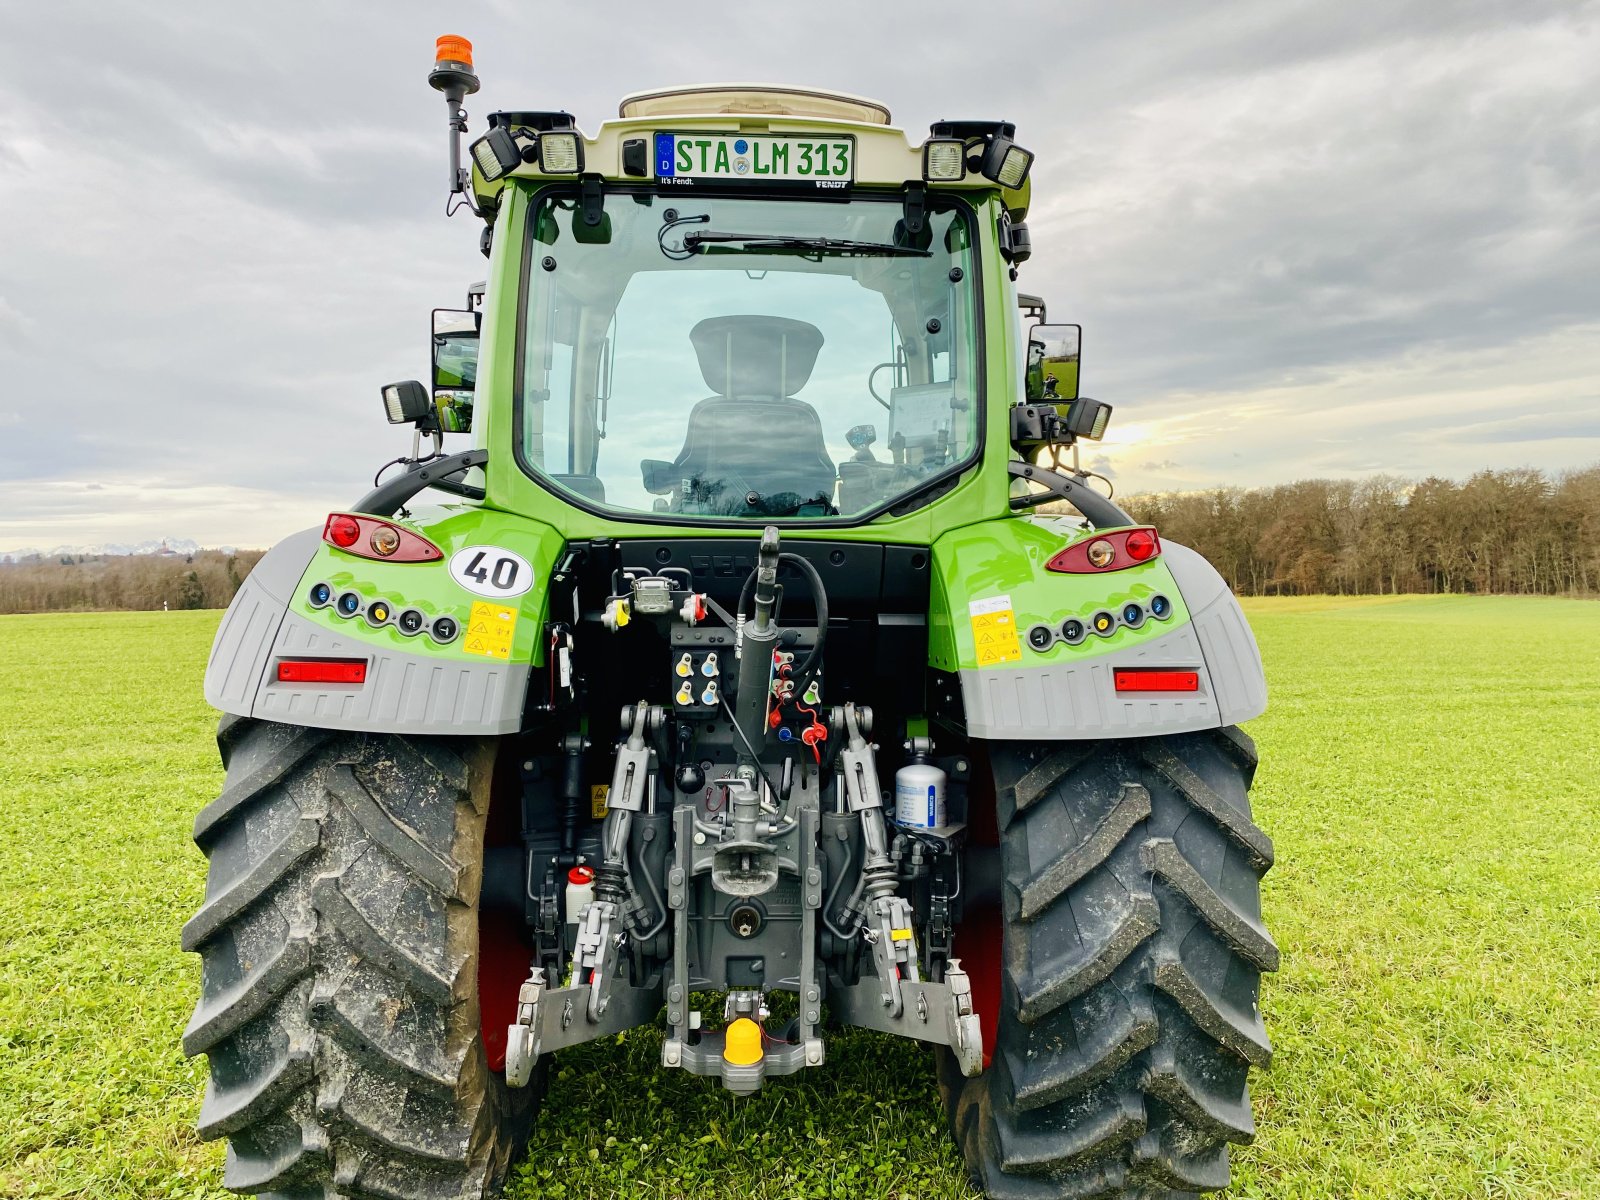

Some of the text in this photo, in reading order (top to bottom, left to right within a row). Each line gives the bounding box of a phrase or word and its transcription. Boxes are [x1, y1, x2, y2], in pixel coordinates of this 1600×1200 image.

[676, 140, 849, 175] STA LM 313
[662, 160, 670, 170] D
[661, 177, 694, 185] It's Fendt.
[815, 180, 848, 188] FENDT
[463, 551, 520, 590] 40
